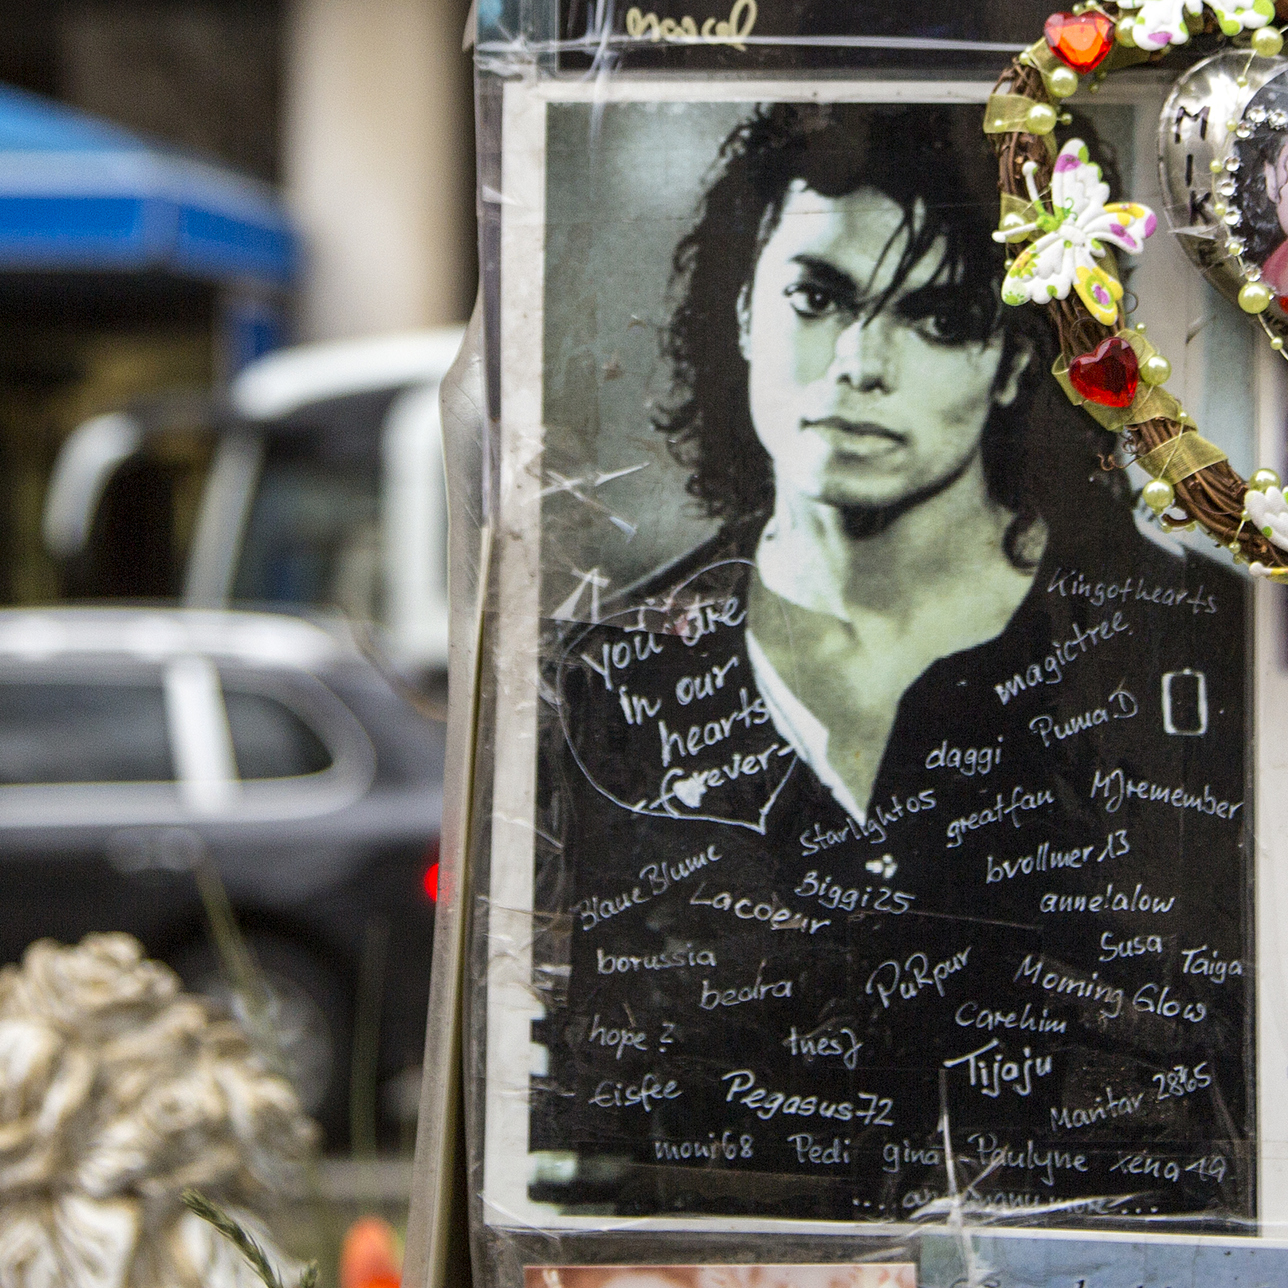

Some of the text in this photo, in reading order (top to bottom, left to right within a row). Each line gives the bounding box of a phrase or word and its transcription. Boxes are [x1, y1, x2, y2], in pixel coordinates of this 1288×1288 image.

[619, 657, 739, 725] in our
[658, 688, 770, 768] hearts
[925, 735, 1004, 776] daggi
[596, 944, 717, 975] borussia
[1098, 931, 1163, 962] Susa
[1181, 945, 1243, 984] Taiga
[588, 1014, 648, 1060] hope
